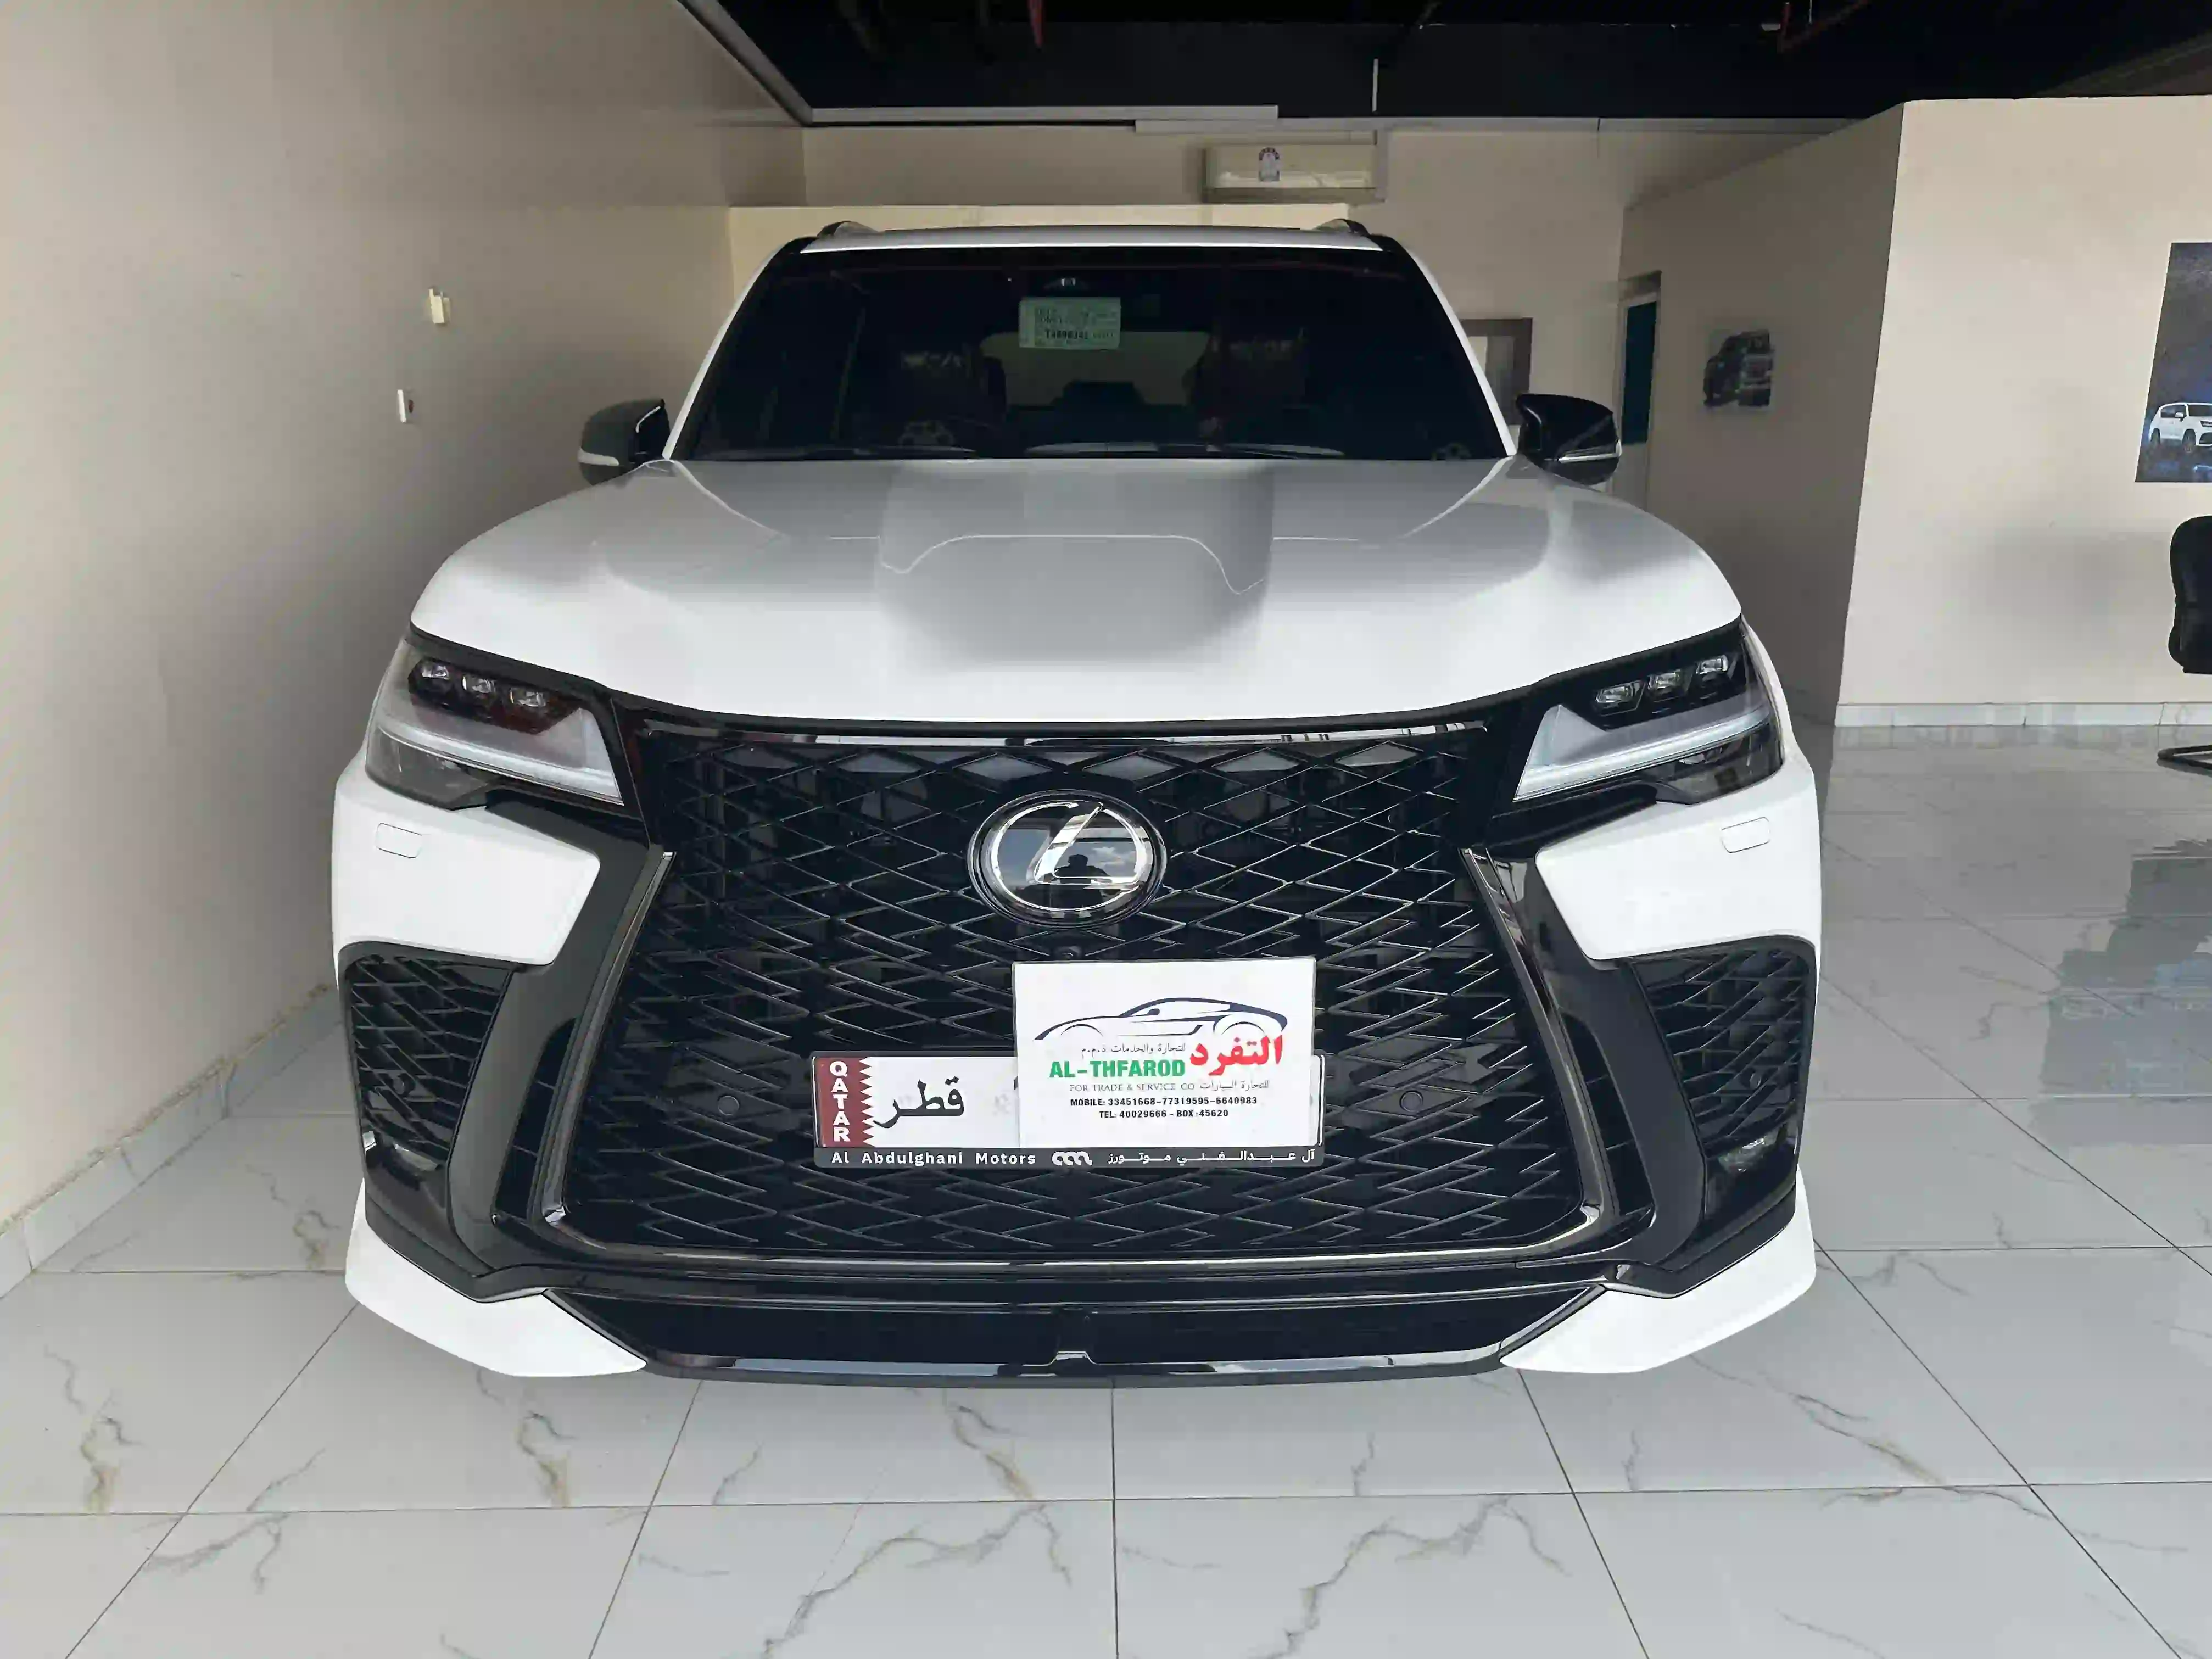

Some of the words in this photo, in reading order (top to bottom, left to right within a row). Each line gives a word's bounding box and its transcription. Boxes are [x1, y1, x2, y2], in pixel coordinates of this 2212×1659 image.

[1189, 1034, 1283, 1076] التفرد
[1049, 1059, 1186, 1078] AL-THFAROD
[1136, 1083, 1176, 1091] SERVICE
[829, 1060, 851, 1143] QATAR
[873, 1076, 964, 1129] قطر
[1070, 1098, 1105, 1107] MOBILE:
[1119, 1110, 1167, 1119] 40029666
[831, 1151, 850, 1164] Al
[861, 1151, 963, 1167] Abdulghani
[975, 1153, 1036, 1165] Motors
[1108, 1152, 1172, 1165] موتورز
